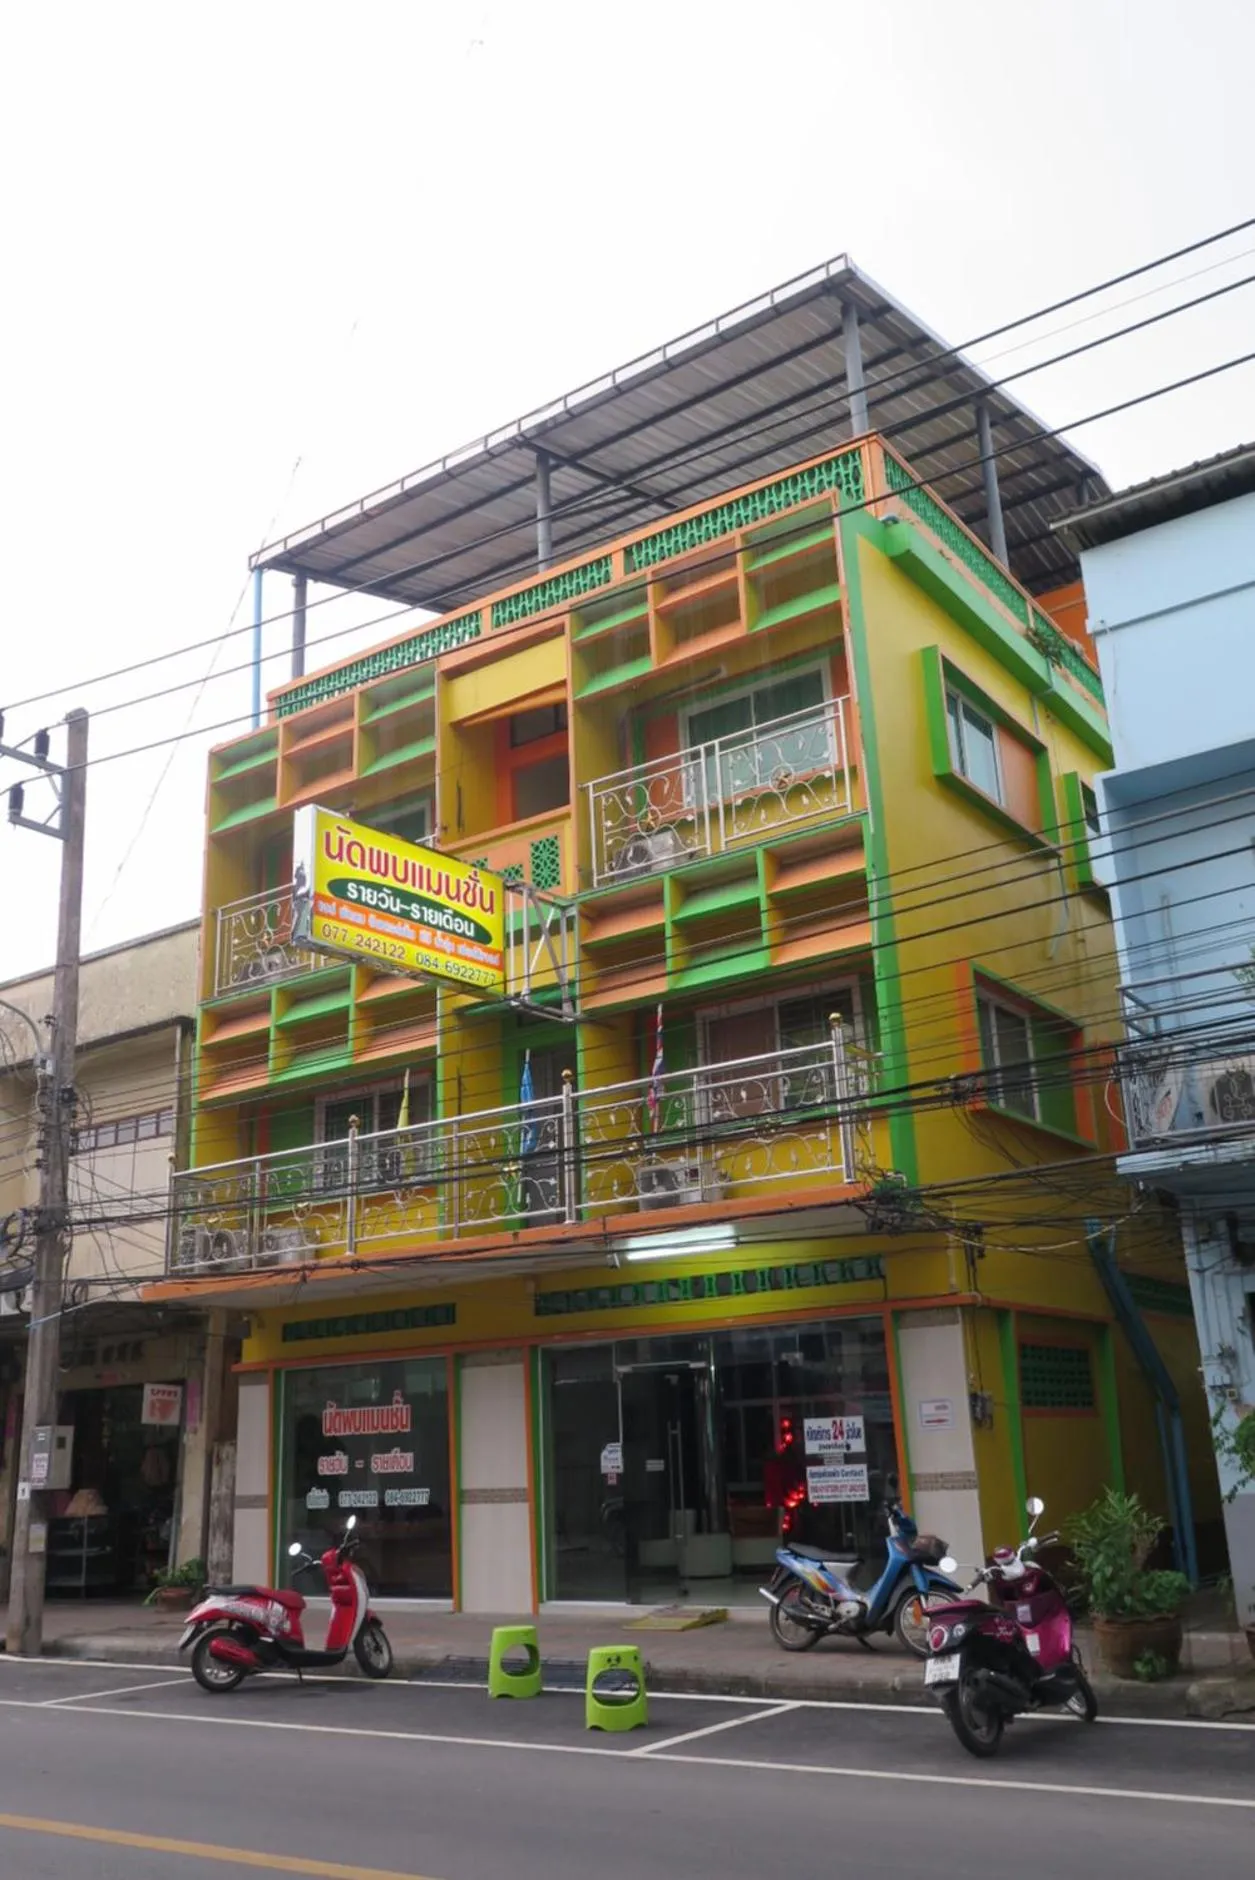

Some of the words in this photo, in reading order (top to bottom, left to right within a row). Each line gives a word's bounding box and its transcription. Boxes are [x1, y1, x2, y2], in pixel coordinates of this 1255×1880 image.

[324, 825, 495, 915] นัดพบแมนชั่น
[322, 923, 348, 942] 077
[355, 933, 406, 959] 242122
[415, 952, 439, 969] 084
[323, 1391, 411, 1436] นัดพบแมนชั่น
[832, 1420, 845, 1441] 24
